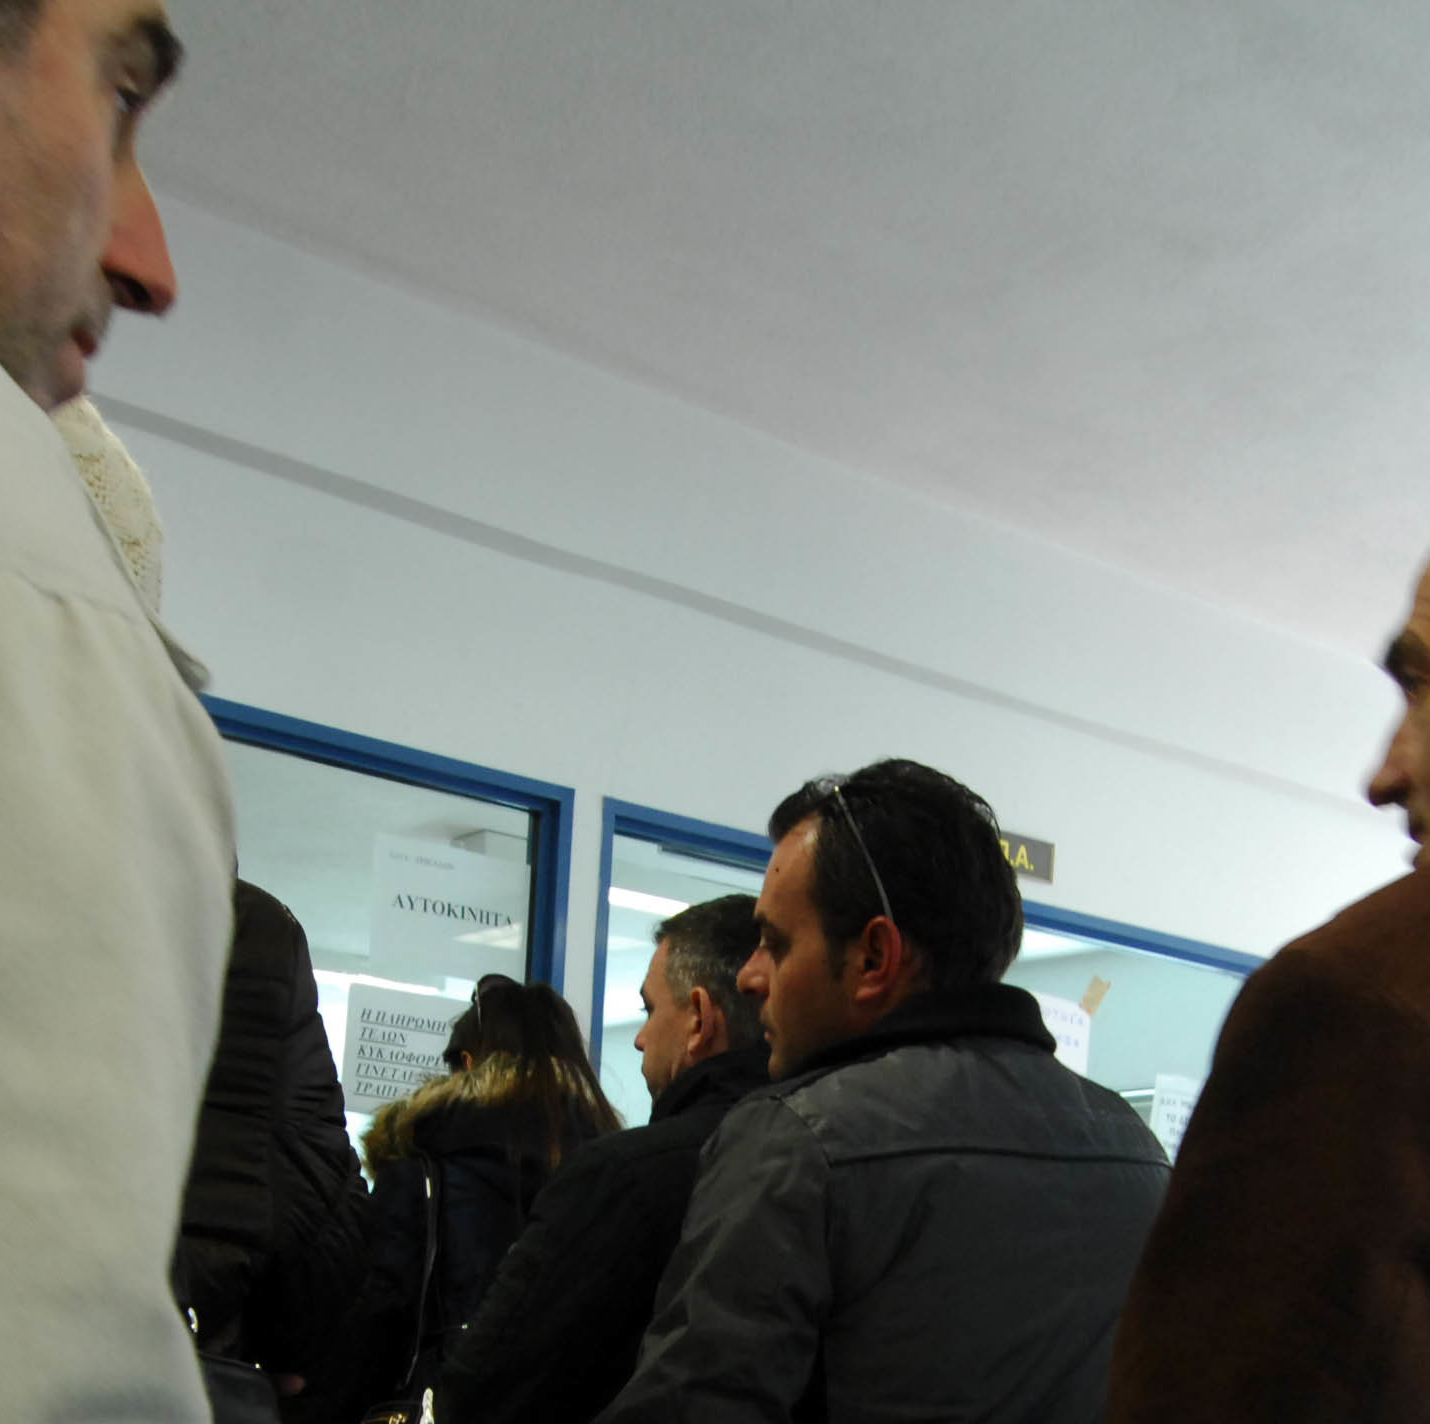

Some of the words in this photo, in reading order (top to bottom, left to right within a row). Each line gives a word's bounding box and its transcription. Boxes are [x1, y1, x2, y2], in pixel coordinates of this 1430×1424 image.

[392, 893, 514, 928] ΑΥΤΟΚΙΝΗΤΑ
[360, 1007, 372, 1021] Η
[375, 1010, 447, 1034] ΠΛΗΡΩΜΗ
[360, 1027, 407, 1044] ΤΕΛΩΝ
